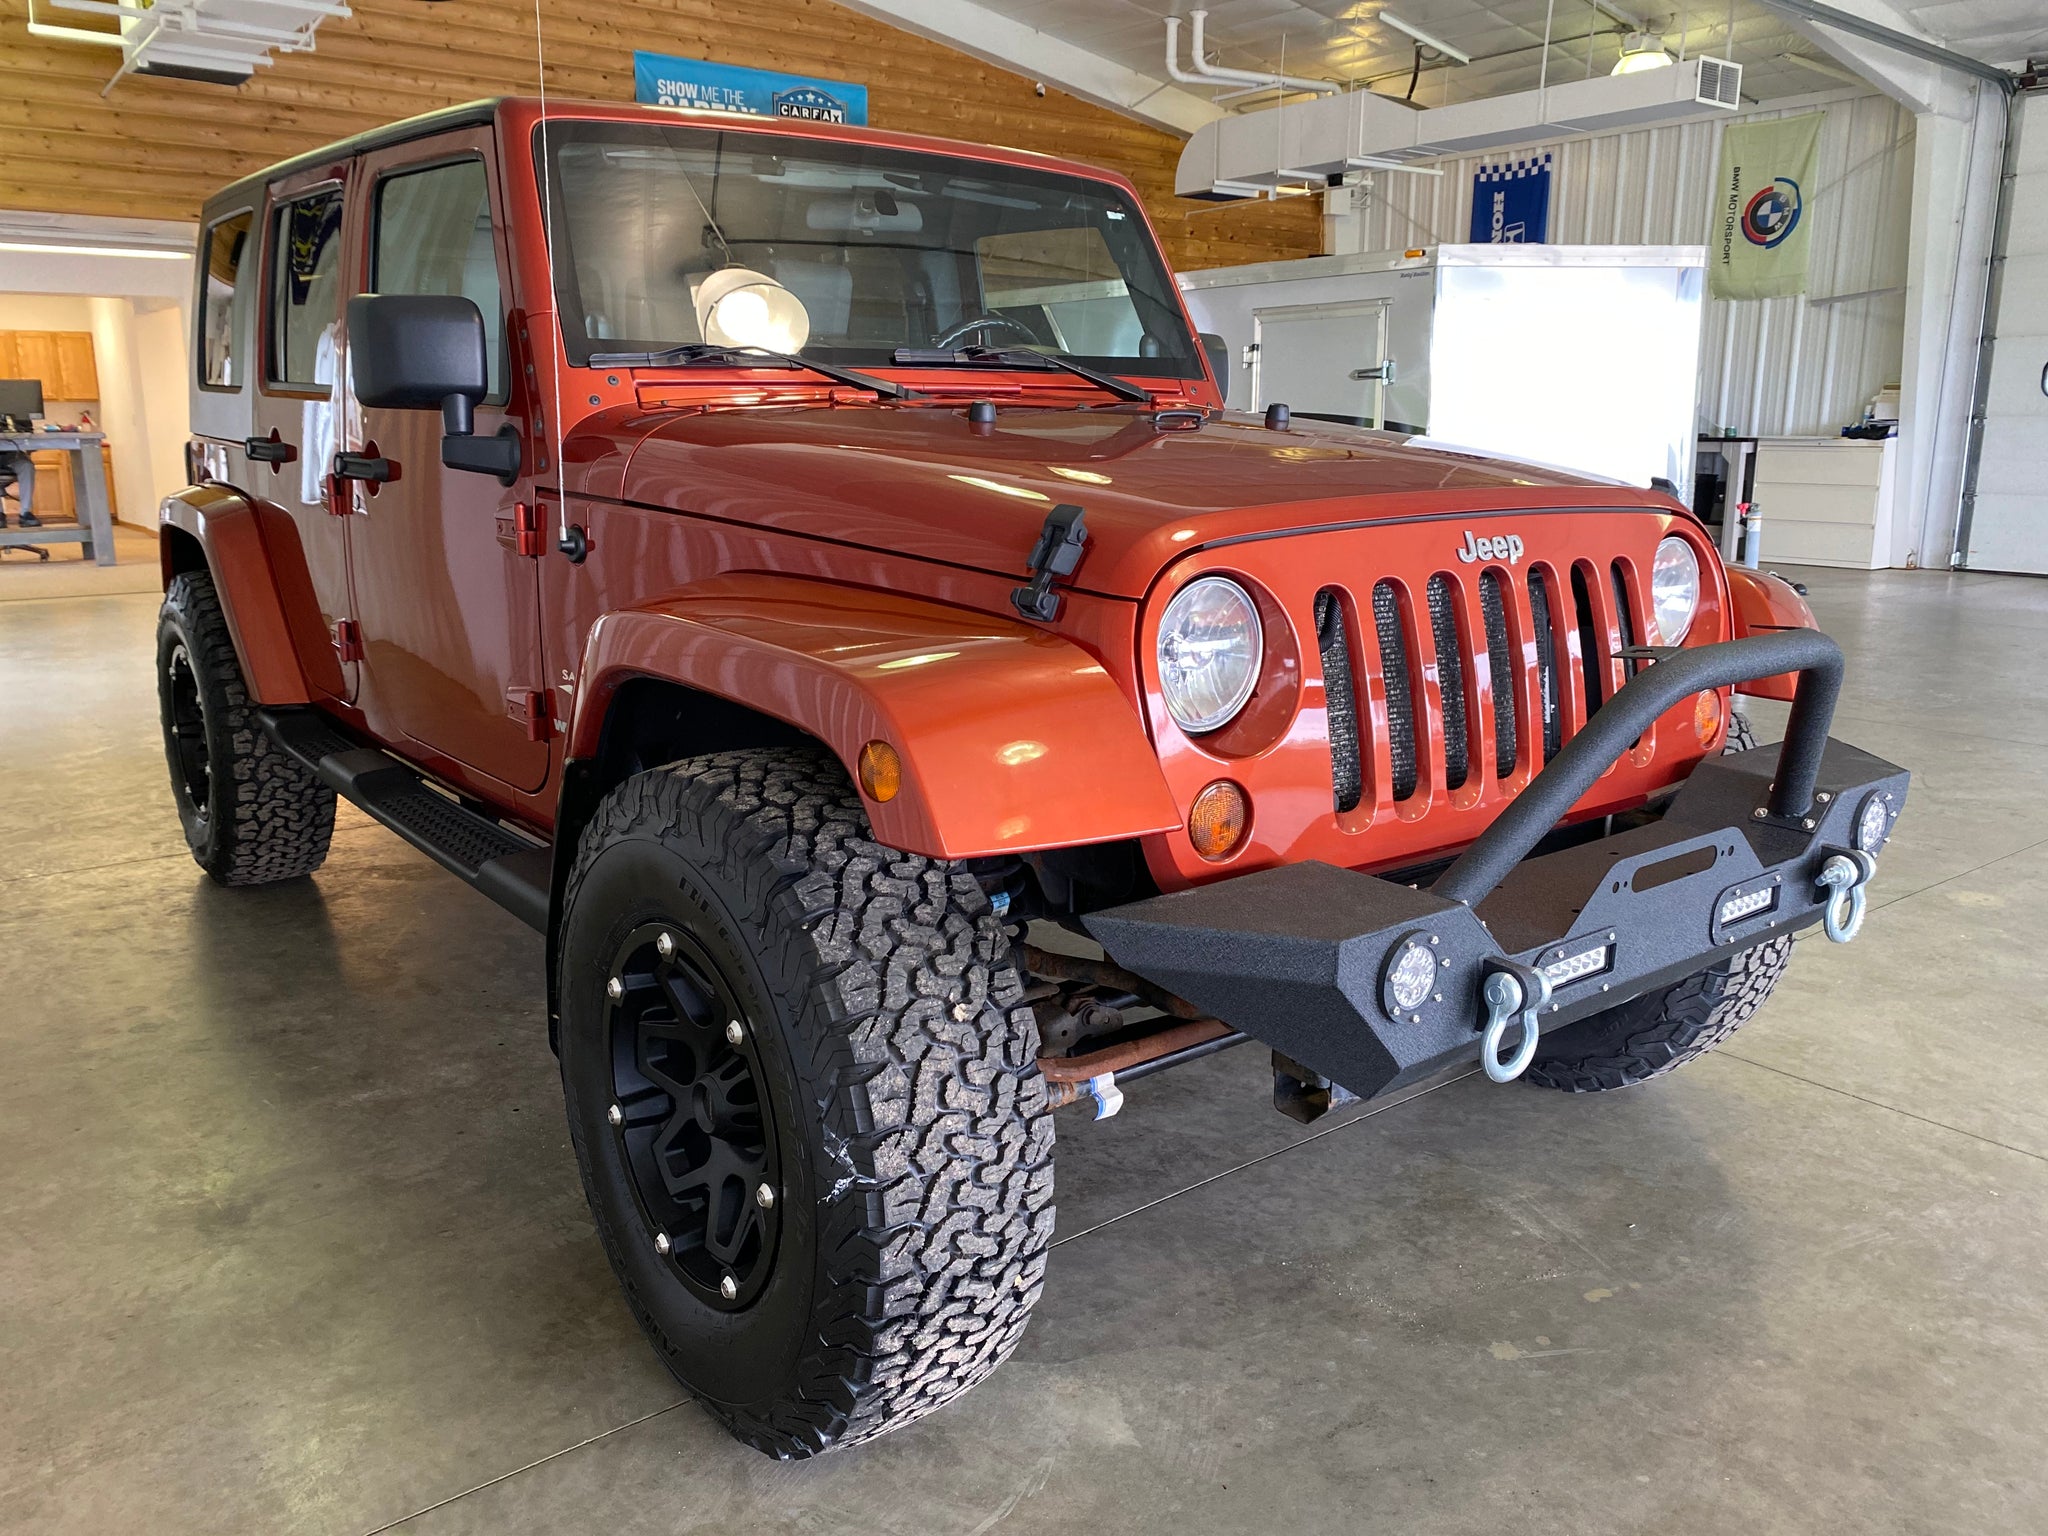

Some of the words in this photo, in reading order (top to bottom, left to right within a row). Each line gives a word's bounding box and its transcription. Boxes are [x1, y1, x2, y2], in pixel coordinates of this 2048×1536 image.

[657, 78, 698, 99] SHOW
[701, 85, 720, 103] ME
[722, 88, 745, 106] THE
[780, 104, 841, 123] CARFAX
[1730, 166, 1741, 192] BMW
[1722, 194, 1739, 267] MOTORSPORT
[1456, 530, 1525, 565] Jeep
